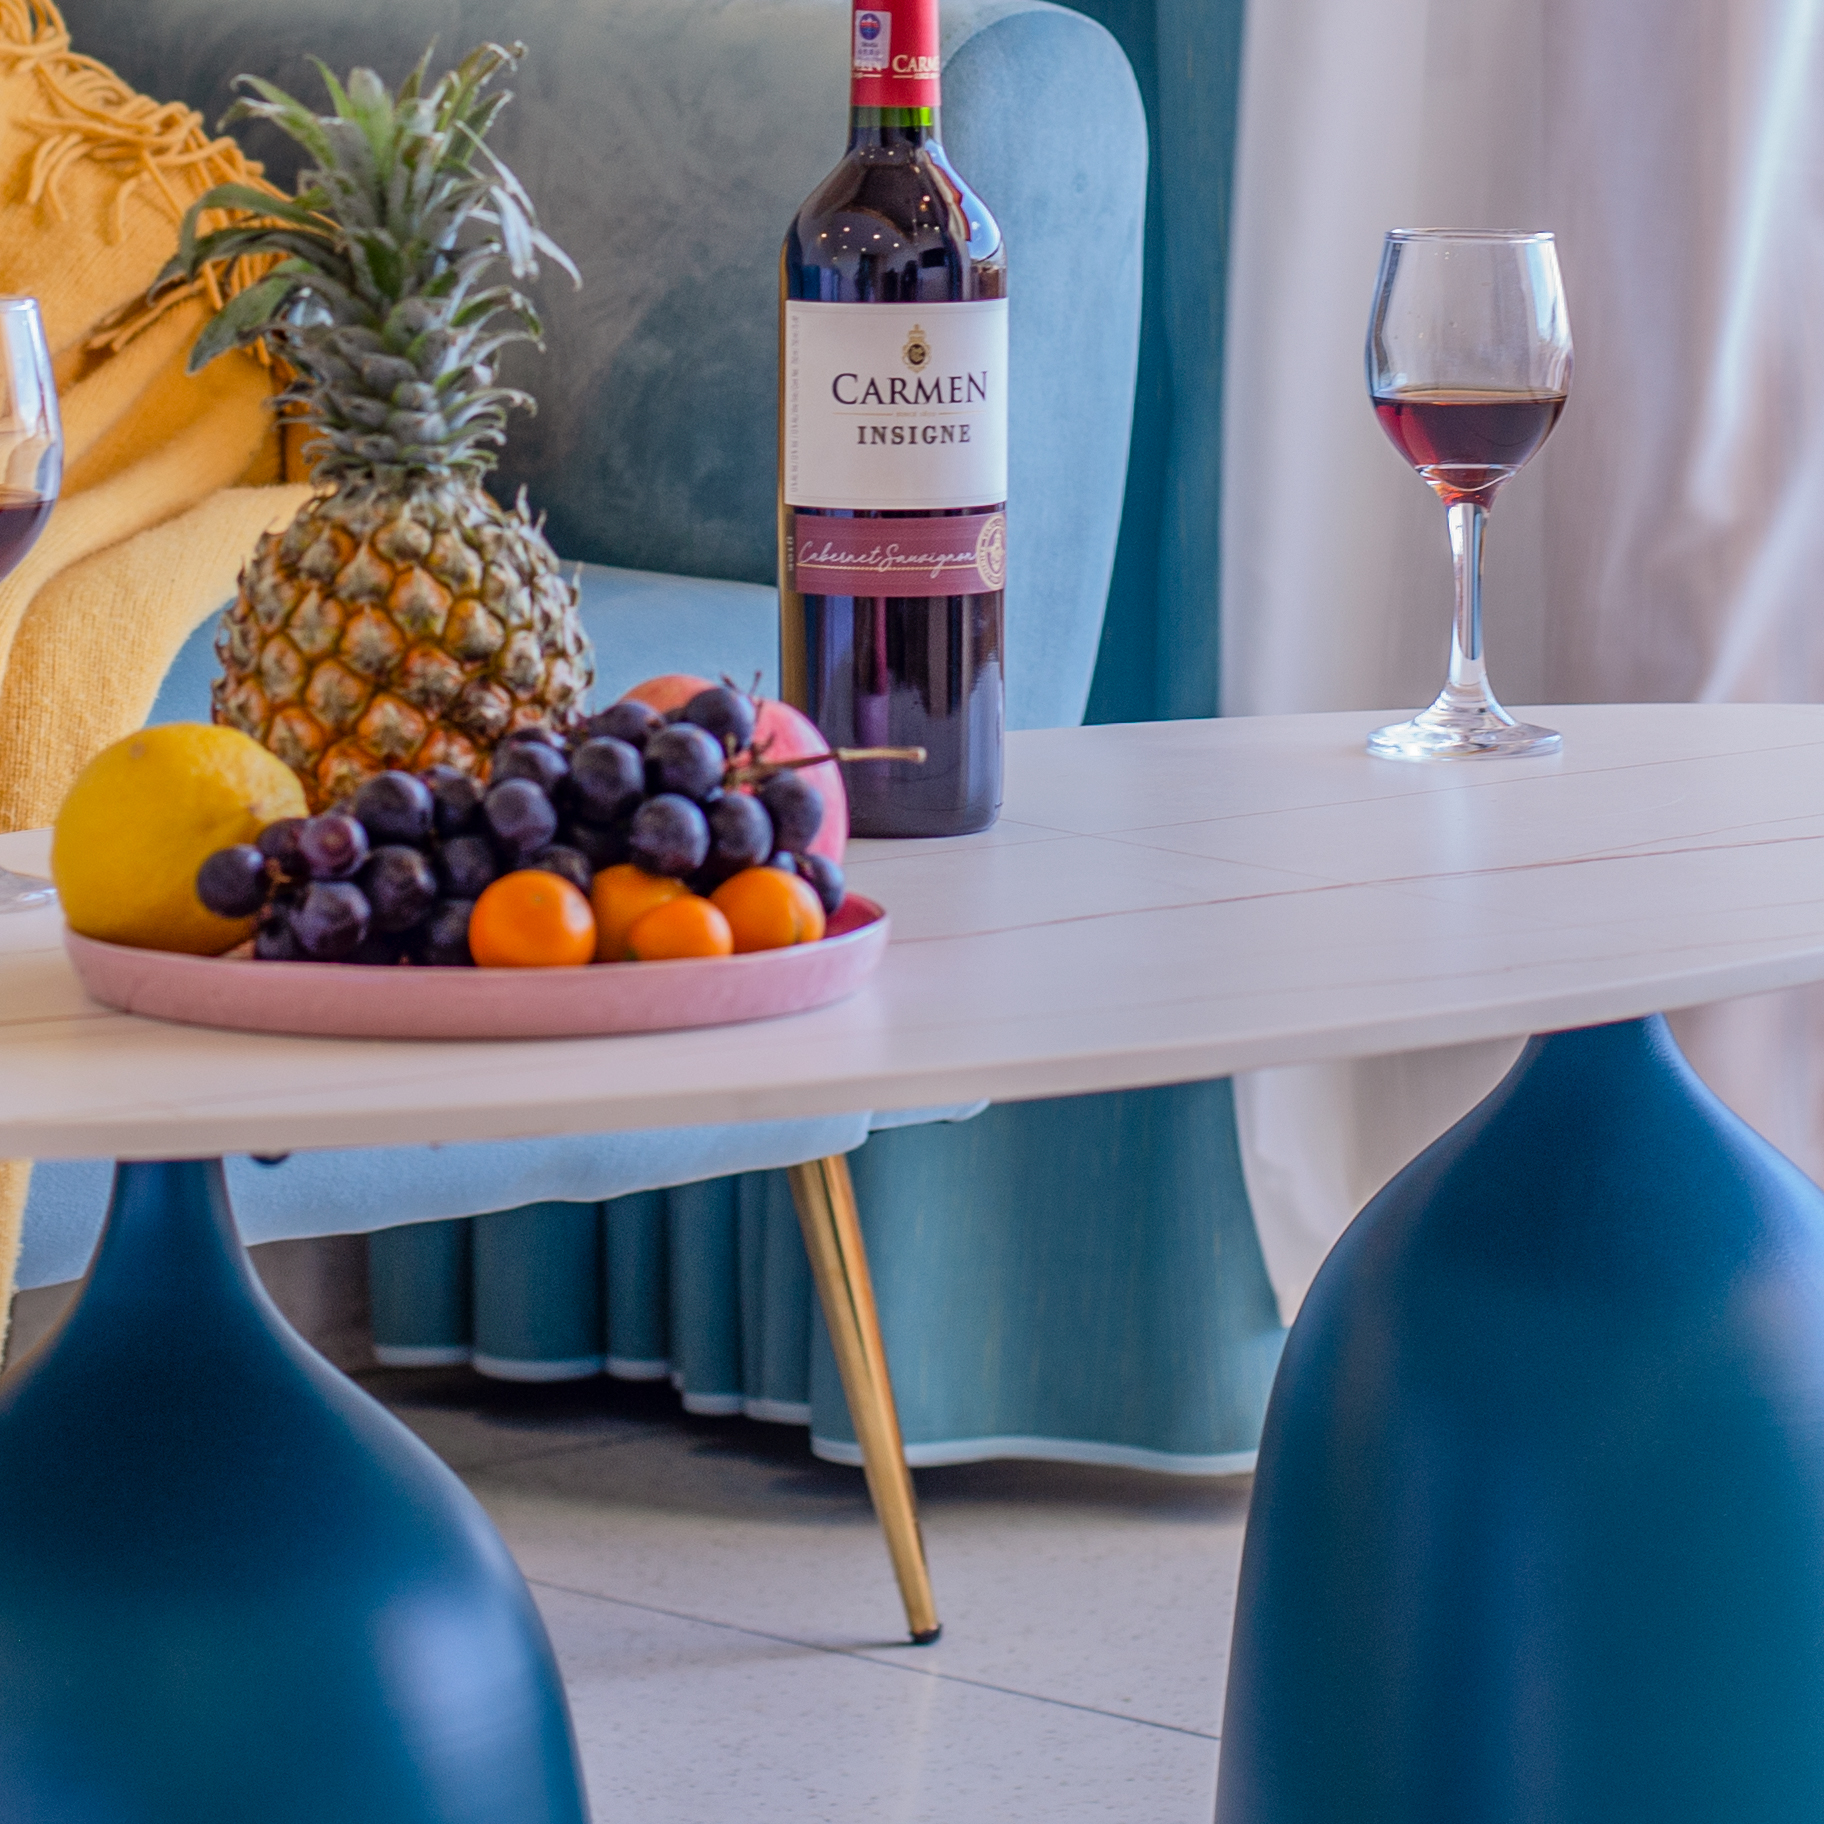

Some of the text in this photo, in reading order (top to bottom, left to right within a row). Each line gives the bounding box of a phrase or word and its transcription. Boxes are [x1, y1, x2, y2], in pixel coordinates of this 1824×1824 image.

[832, 371, 988, 405] CARMEN
[857, 425, 971, 445] INSIGNE
[797, 540, 882, 566] Cabernet
[879, 543, 977, 579] Sauvignon
